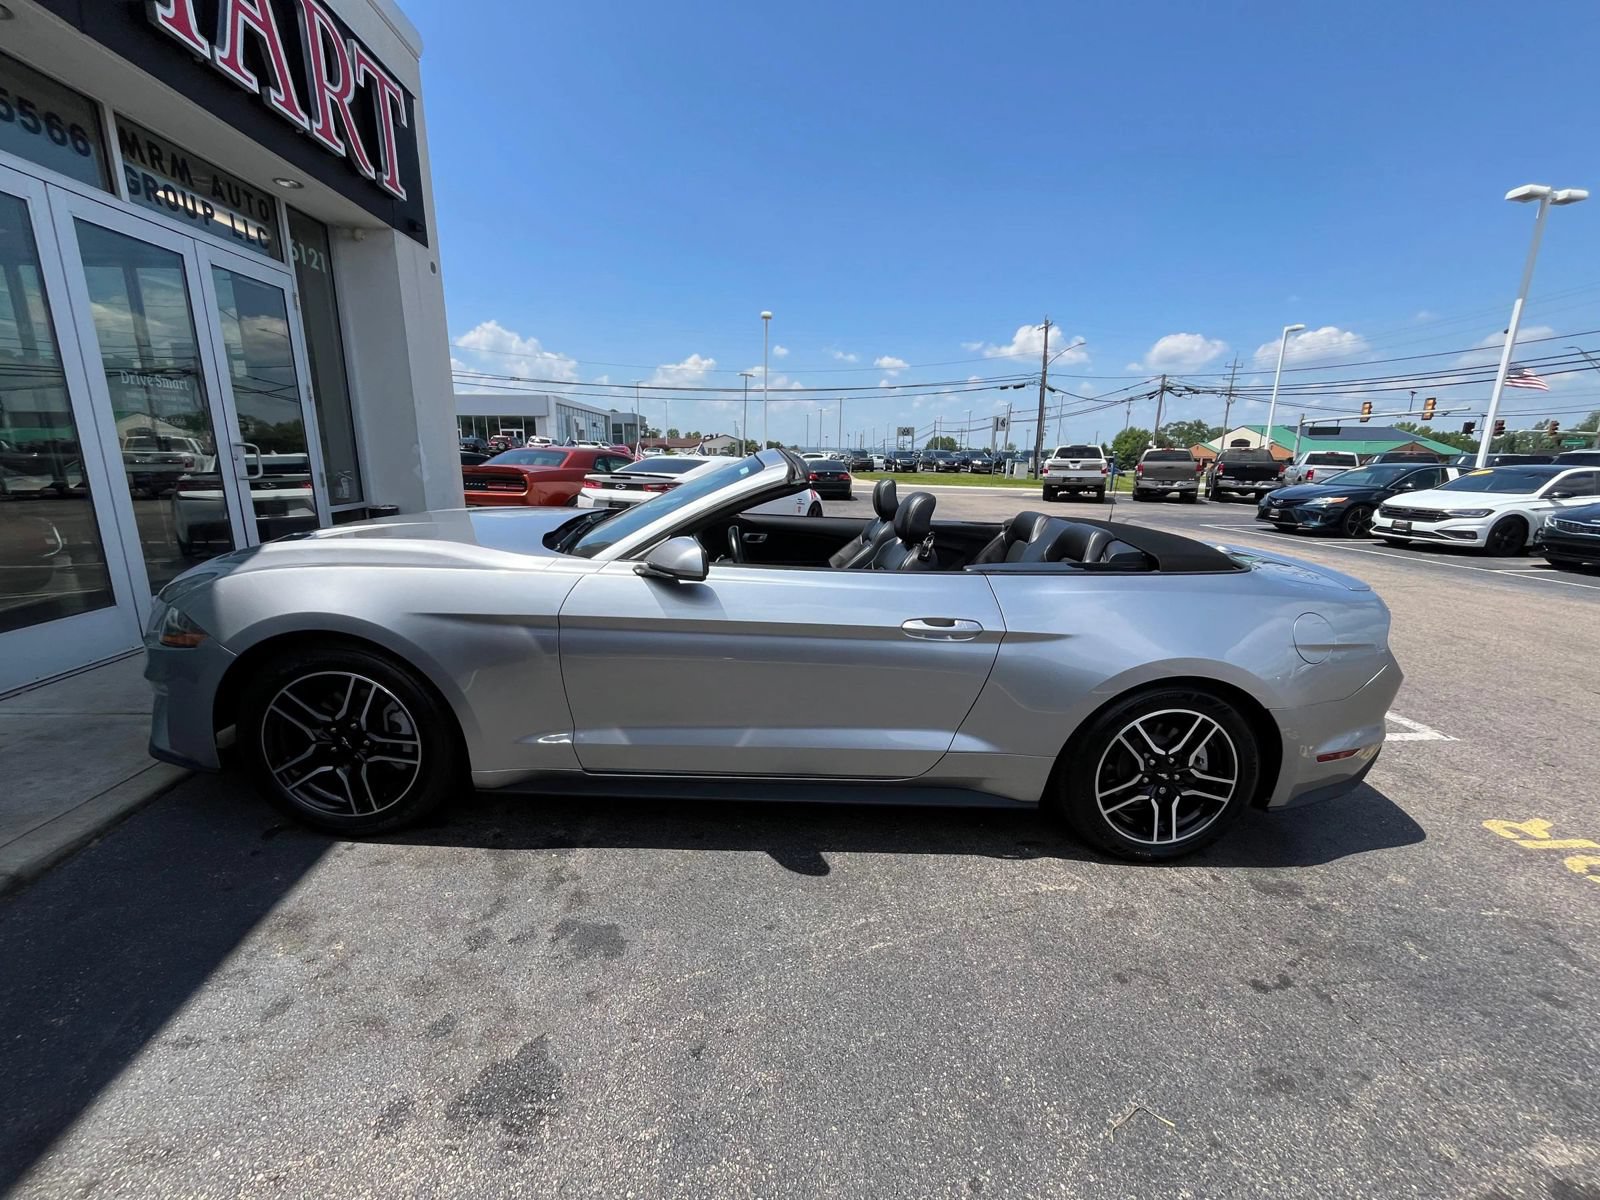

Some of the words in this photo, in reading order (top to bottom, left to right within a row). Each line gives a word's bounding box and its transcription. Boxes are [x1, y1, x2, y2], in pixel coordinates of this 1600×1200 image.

[148, 0, 408, 200] ART
[118, 126, 194, 188] MRM
[211, 174, 270, 221] AUTO
[124, 165, 215, 226] GROUP
[229, 212, 271, 249] LLC
